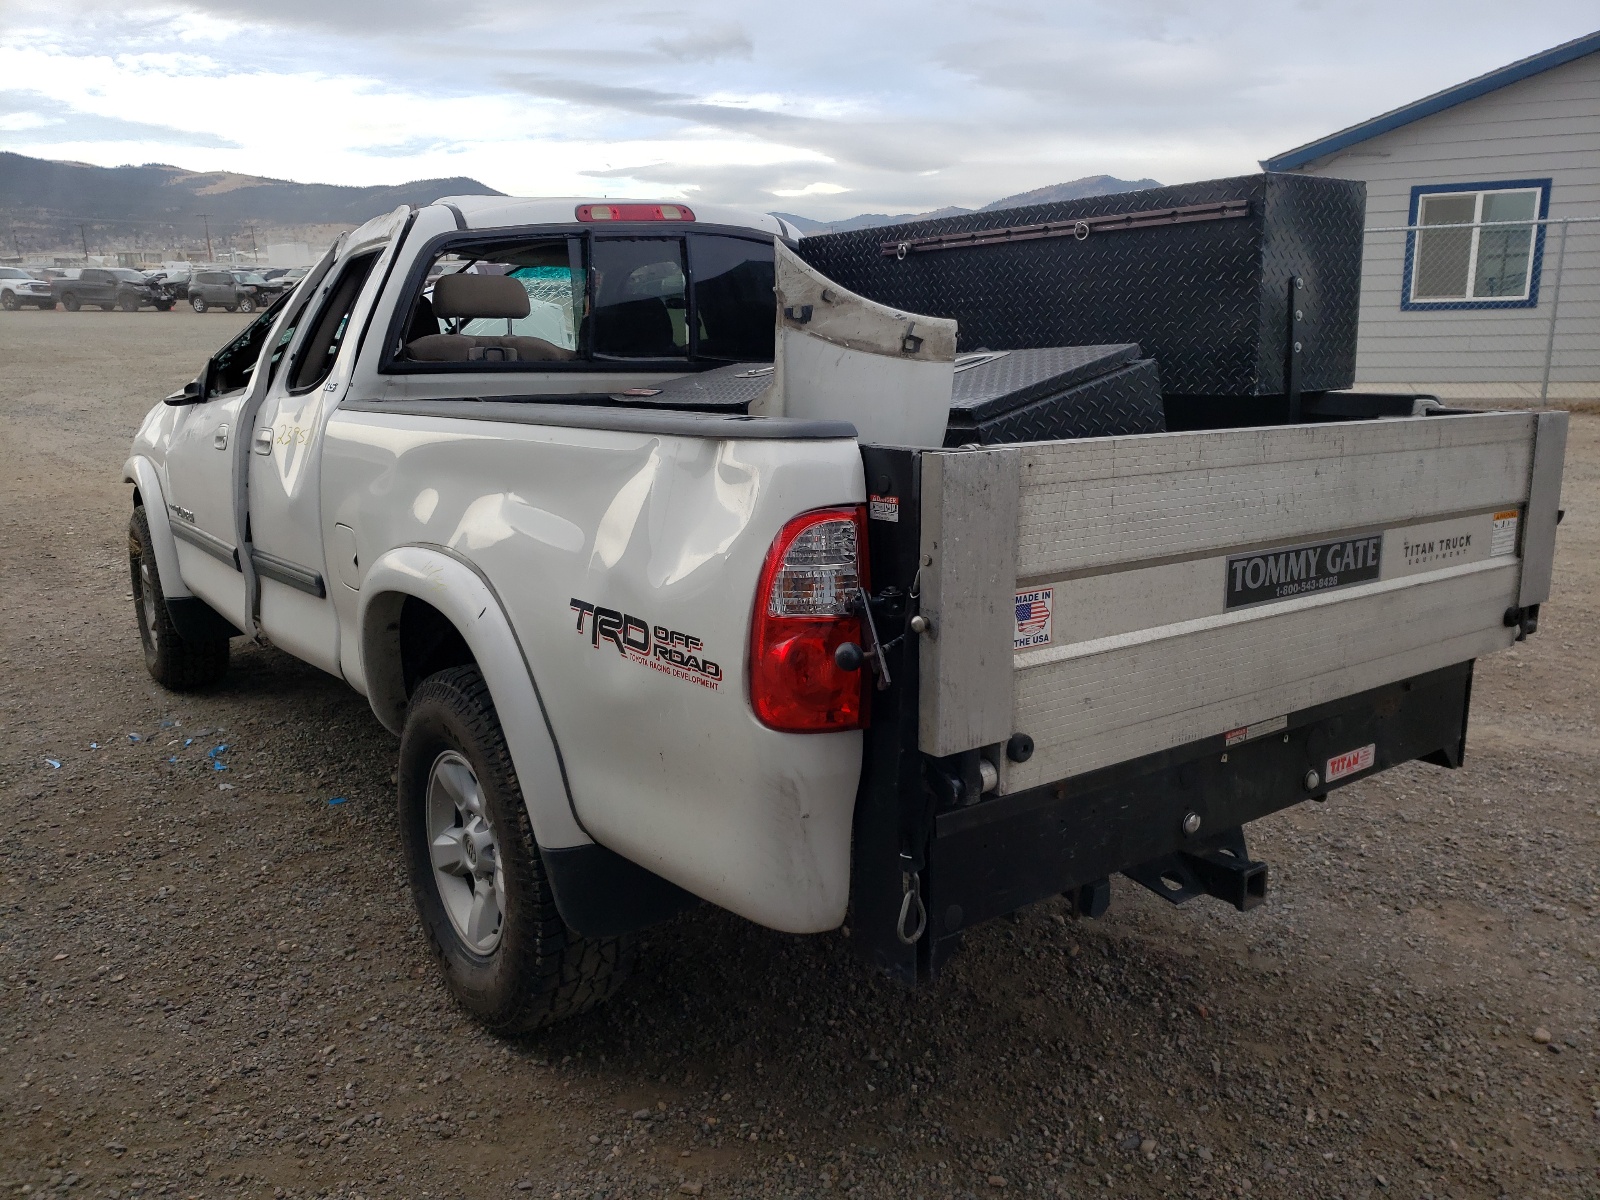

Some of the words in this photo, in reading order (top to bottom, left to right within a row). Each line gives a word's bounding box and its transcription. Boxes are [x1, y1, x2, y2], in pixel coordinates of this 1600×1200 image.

[1404, 541, 1435, 558] TITAN
[1439, 534, 1472, 551] TRUCK
[1408, 549, 1467, 566] EQUIPMENT
[1232, 548, 1321, 592] TOMMY
[1326, 538, 1378, 574] GATE
[1015, 592, 1039, 604] MADE
[1041, 590, 1051, 600] IN
[570, 598, 651, 657] TRD
[1014, 637, 1031, 648] THE
[1032, 633, 1049, 644] USA
[629, 652, 649, 667] TOYOTA
[649, 661, 671, 675] RACING
[672, 668, 719, 691] DEVELOPMENT
[653, 643, 723, 682] ROAD
[1330, 751, 1359, 776] TITAN
